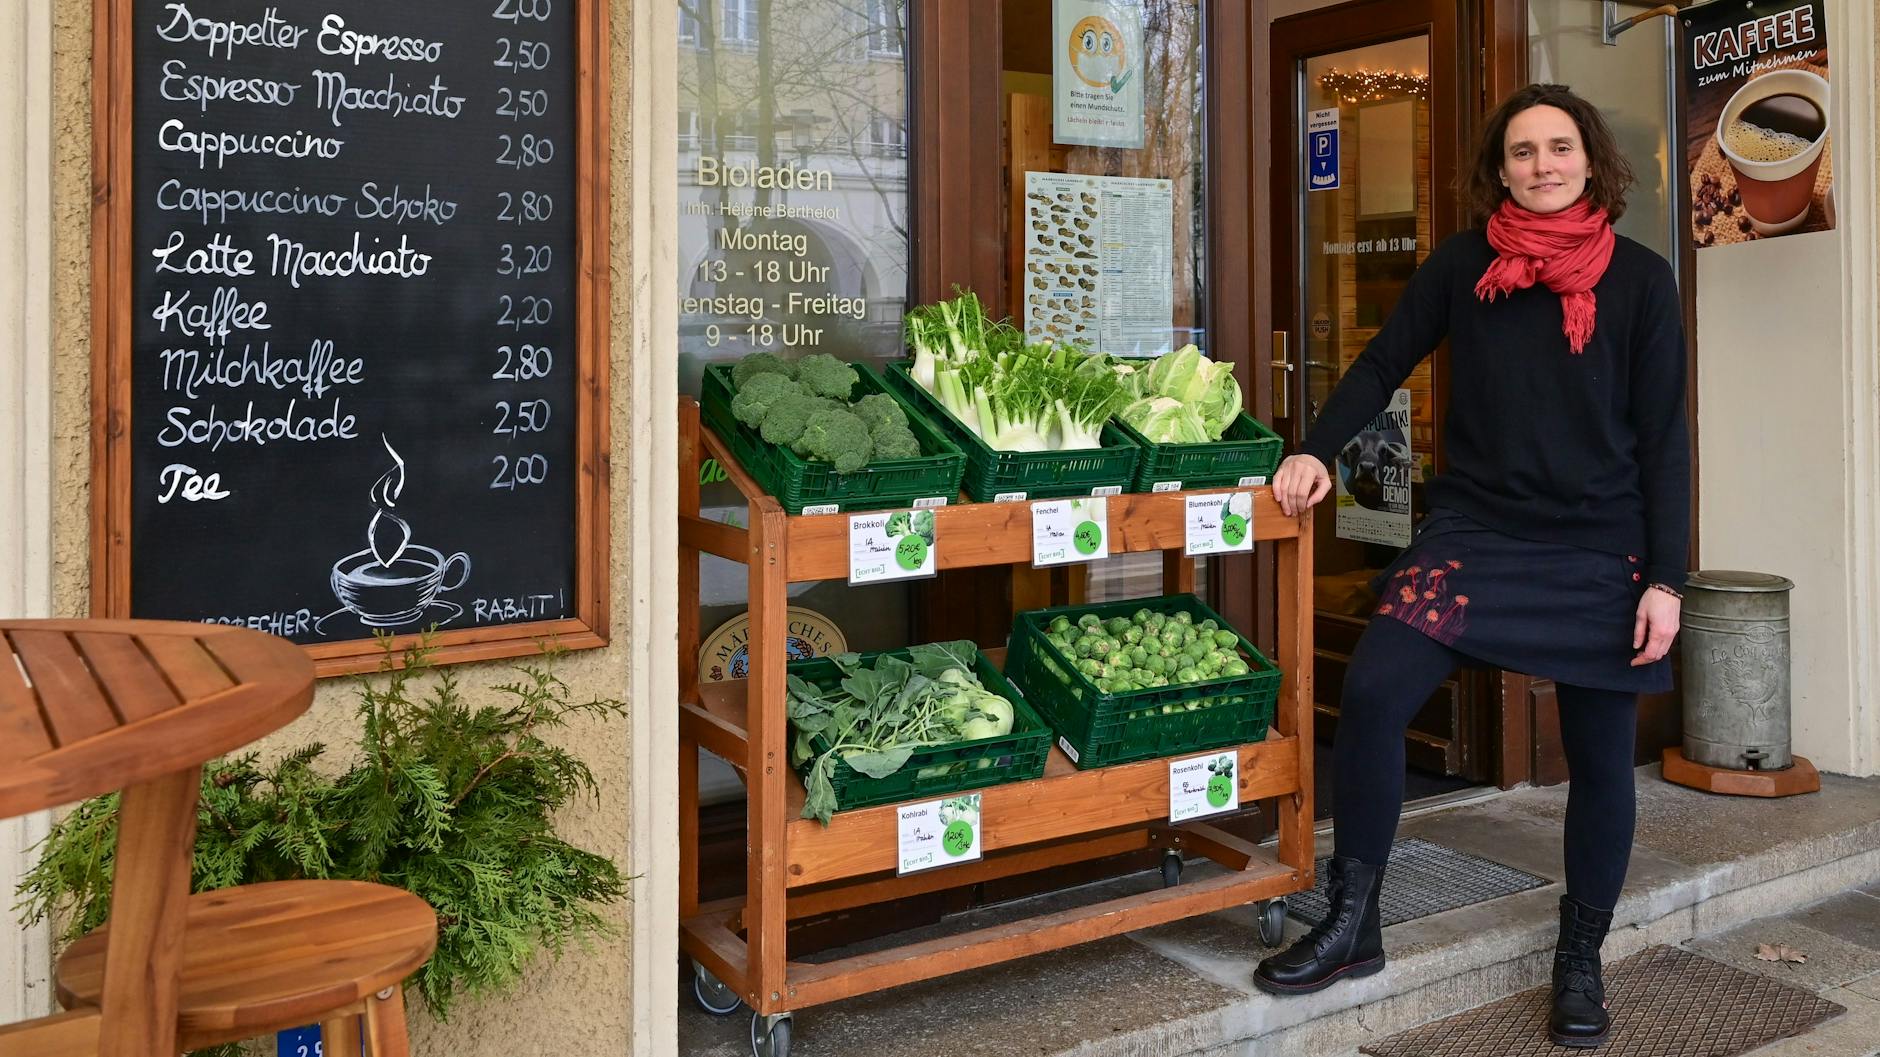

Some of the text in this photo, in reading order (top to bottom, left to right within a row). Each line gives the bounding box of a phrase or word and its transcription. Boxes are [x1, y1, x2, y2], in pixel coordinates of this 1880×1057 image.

[156, 2, 551, 73] Doppelter Espresso 2,50
[1694, 4, 1816, 70] KAFFEE
[1698, 49, 1817, 87] zum Mitnehmen
[159, 59, 548, 127] Espresso Macchiato 2,50
[1070, 90, 1084, 98] Bitte
[1085, 92, 1104, 100] tragen
[1070, 101, 1087, 109] einen
[1316, 111, 1331, 119] Nicht
[1310, 119, 1337, 129] vergessen
[157, 118, 554, 169] Cappuccino 2,80
[1318, 136, 1329, 154] P
[698, 156, 832, 191] Bioladen
[156, 178, 553, 226] Cappuccino Schoko 2,80
[687, 202, 715, 216] Inh.
[776, 204, 840, 219] Berthelot
[721, 228, 807, 256] Montag
[1322, 237, 1417, 255] Montags erst ab 13 Uhr
[151, 230, 552, 288] Latte Macchiato 3,20
[700, 260, 727, 282] 13
[753, 260, 780, 282] 18
[789, 261, 830, 283] Uhr
[151, 286, 553, 346] Kaffee 2,20
[678, 293, 764, 319] ienstag
[788, 292, 866, 320] Freitag
[706, 324, 720, 347] 9
[746, 324, 773, 346] 18
[782, 324, 823, 346] Uhr
[159, 338, 553, 399] Milchkaffee 2,80
[157, 398, 551, 452] Schokolade 2,50
[1363, 410, 1409, 432] POLITIK!
[157, 453, 548, 504] Tee 2,00
[1189, 499, 1223, 508] Blumenkohl
[1383, 486, 1409, 505] DEMO
[1036, 507, 1058, 515] Fenchel
[853, 520, 884, 530] Brokkoli
[1173, 763, 1203, 774] Rosenkohl
[901, 809, 928, 820] Kohlrabi
